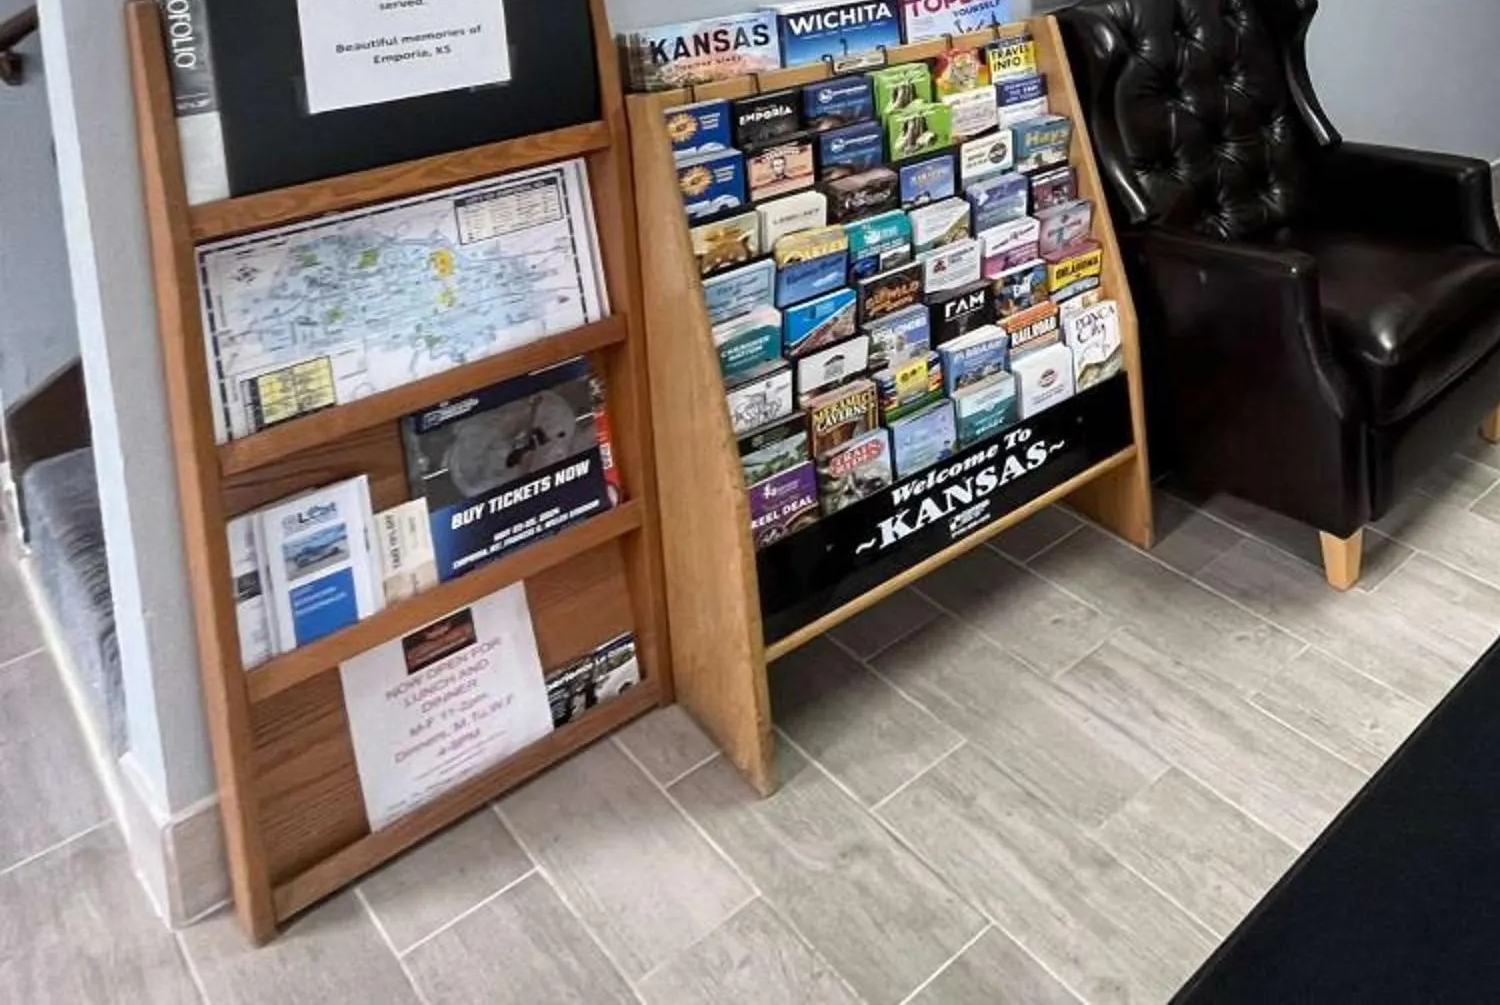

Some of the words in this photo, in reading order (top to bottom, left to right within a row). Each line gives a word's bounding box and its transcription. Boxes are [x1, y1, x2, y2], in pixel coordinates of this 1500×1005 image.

[788, 3, 892, 36] WICHITA
[335, 36, 399, 54] Beautiful
[402, 27, 465, 45] memories
[468, 24, 482, 35] of
[436, 45, 452, 56] KS
[649, 23, 771, 65] KANSAS
[739, 105, 793, 126] EMPORIA
[891, 443, 1000, 506] Welcome
[1003, 427, 1033, 450] To
[451, 502, 486, 530] BUY
[488, 477, 551, 514] TICKETS
[555, 459, 591, 489] NOW
[782, 496, 815, 516] DEAL
